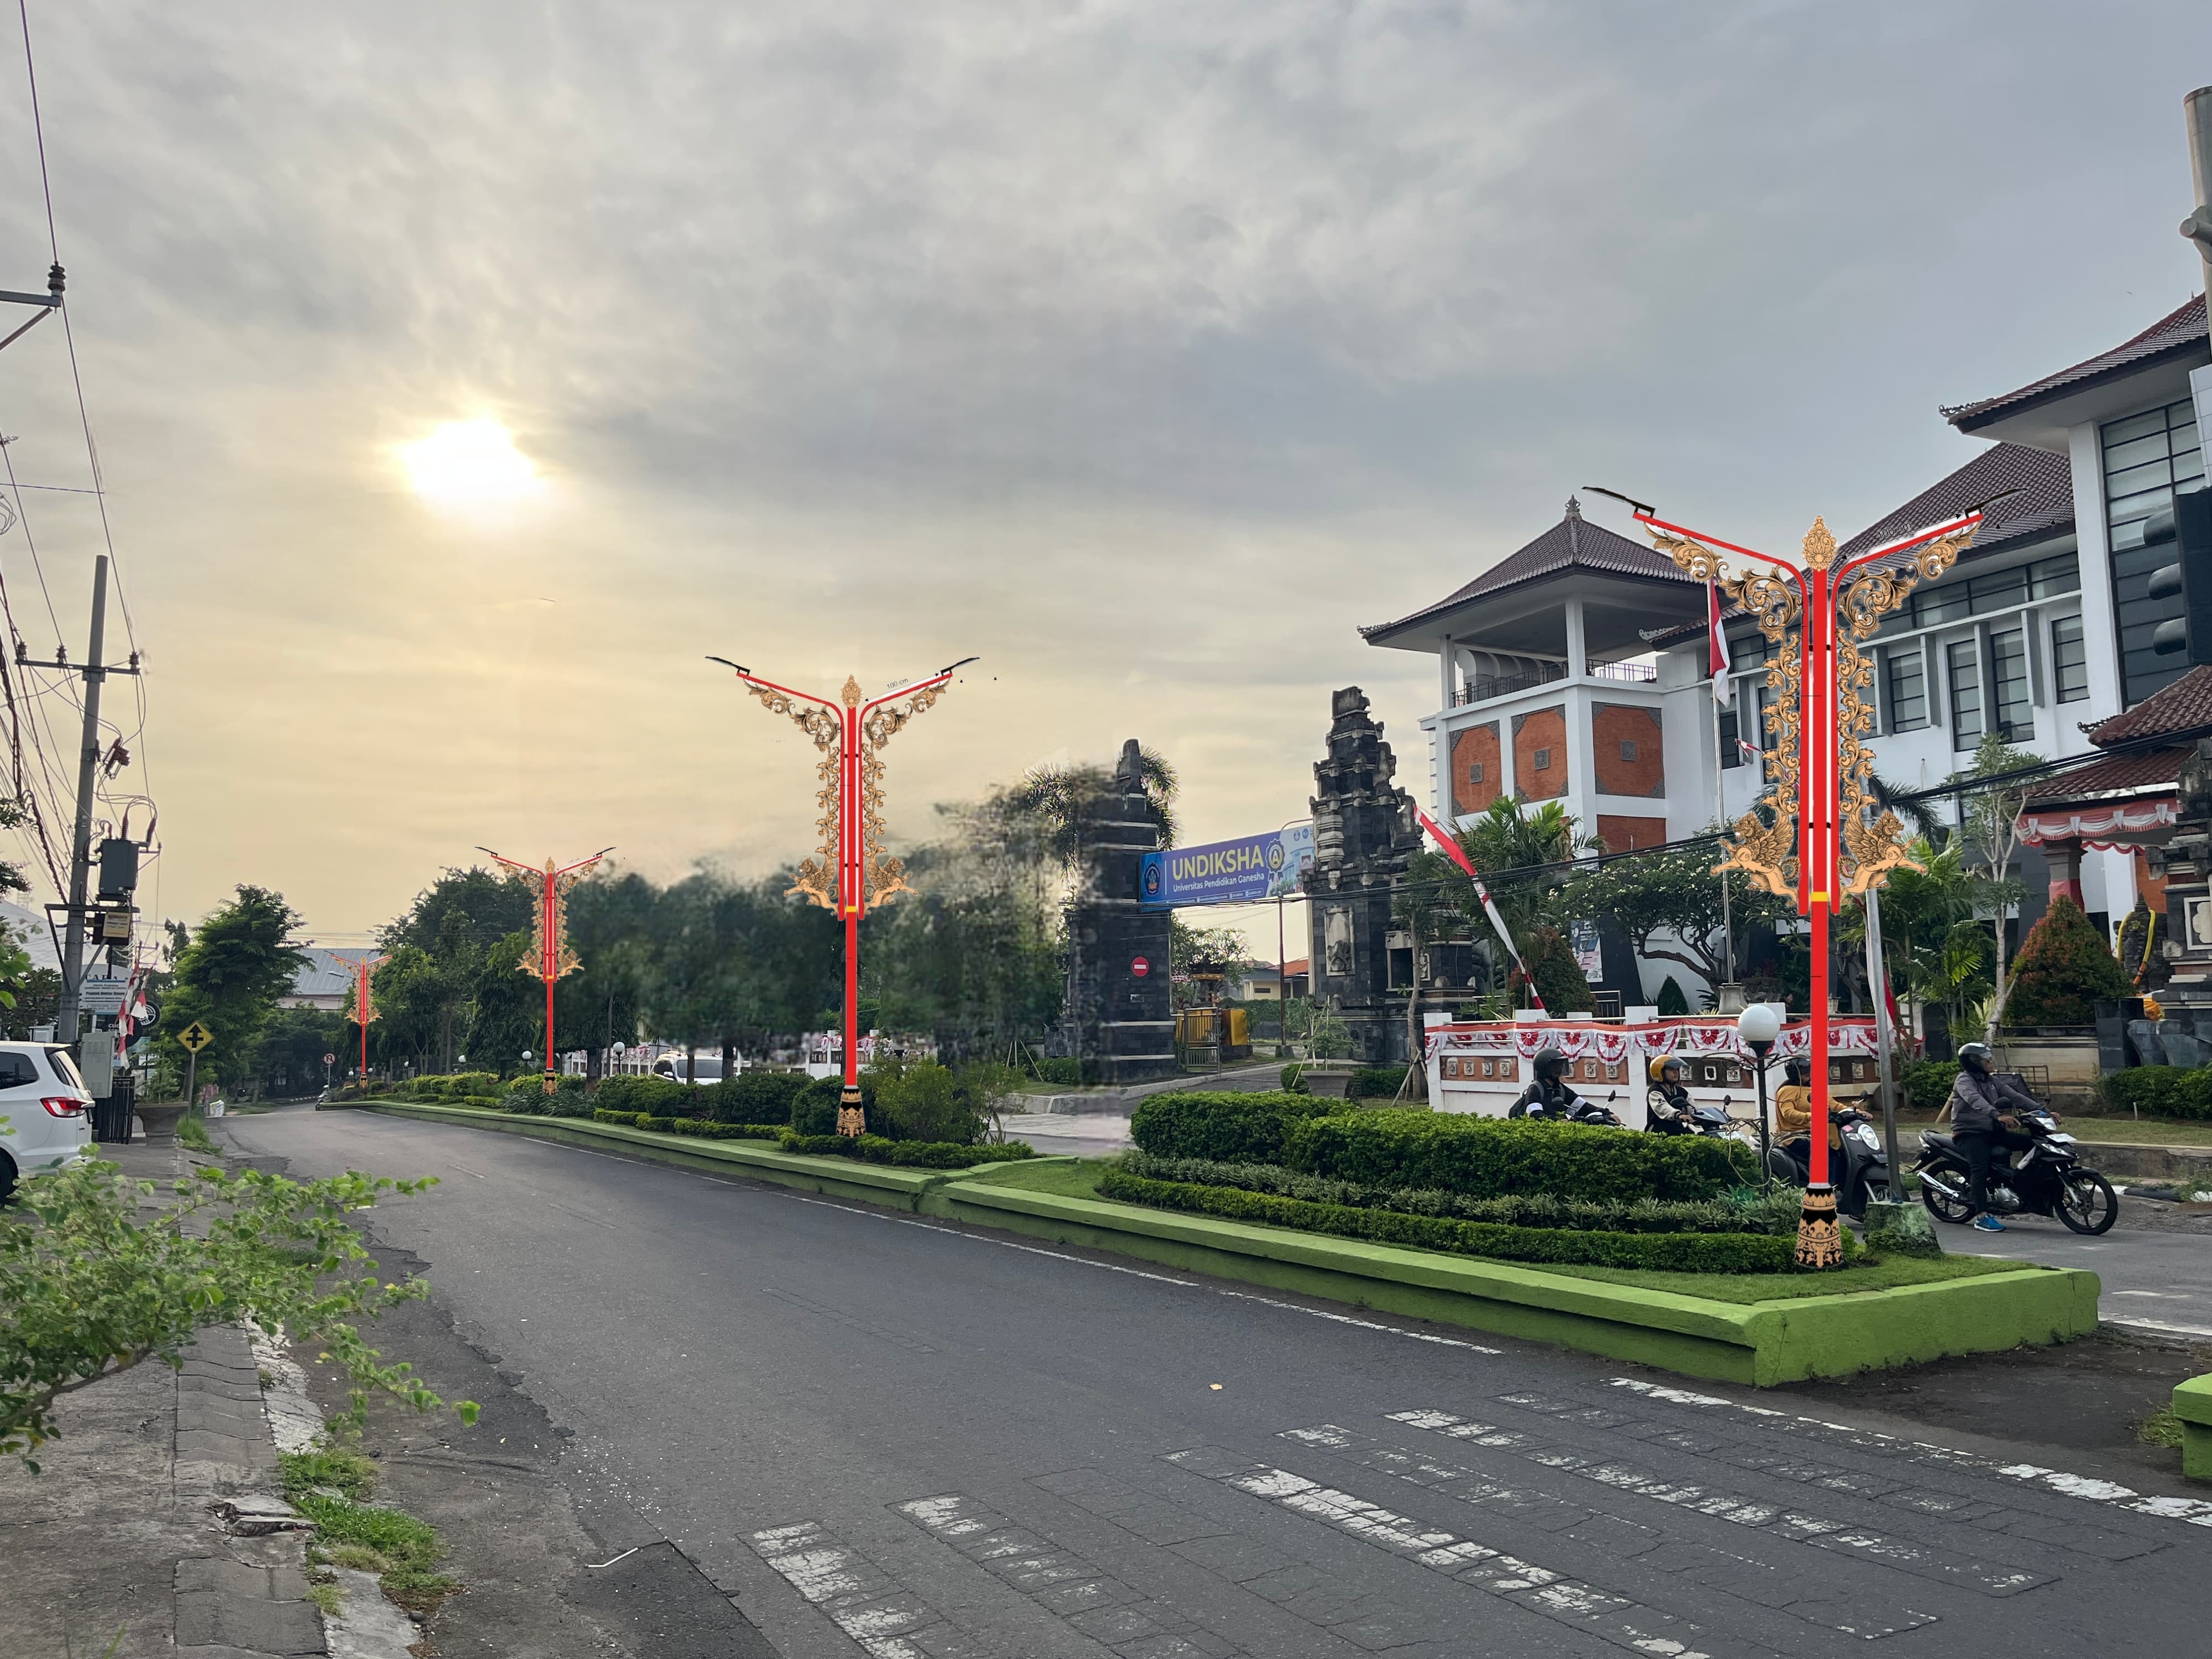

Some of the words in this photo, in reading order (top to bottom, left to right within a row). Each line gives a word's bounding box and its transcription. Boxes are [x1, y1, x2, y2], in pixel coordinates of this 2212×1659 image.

[1172, 845, 1264, 880] UNDIKSHA
[1173, 881, 1203, 892] Universitas
[1204, 877, 1237, 888] Pendidikan
[1238, 872, 1265, 884] Ganesha
